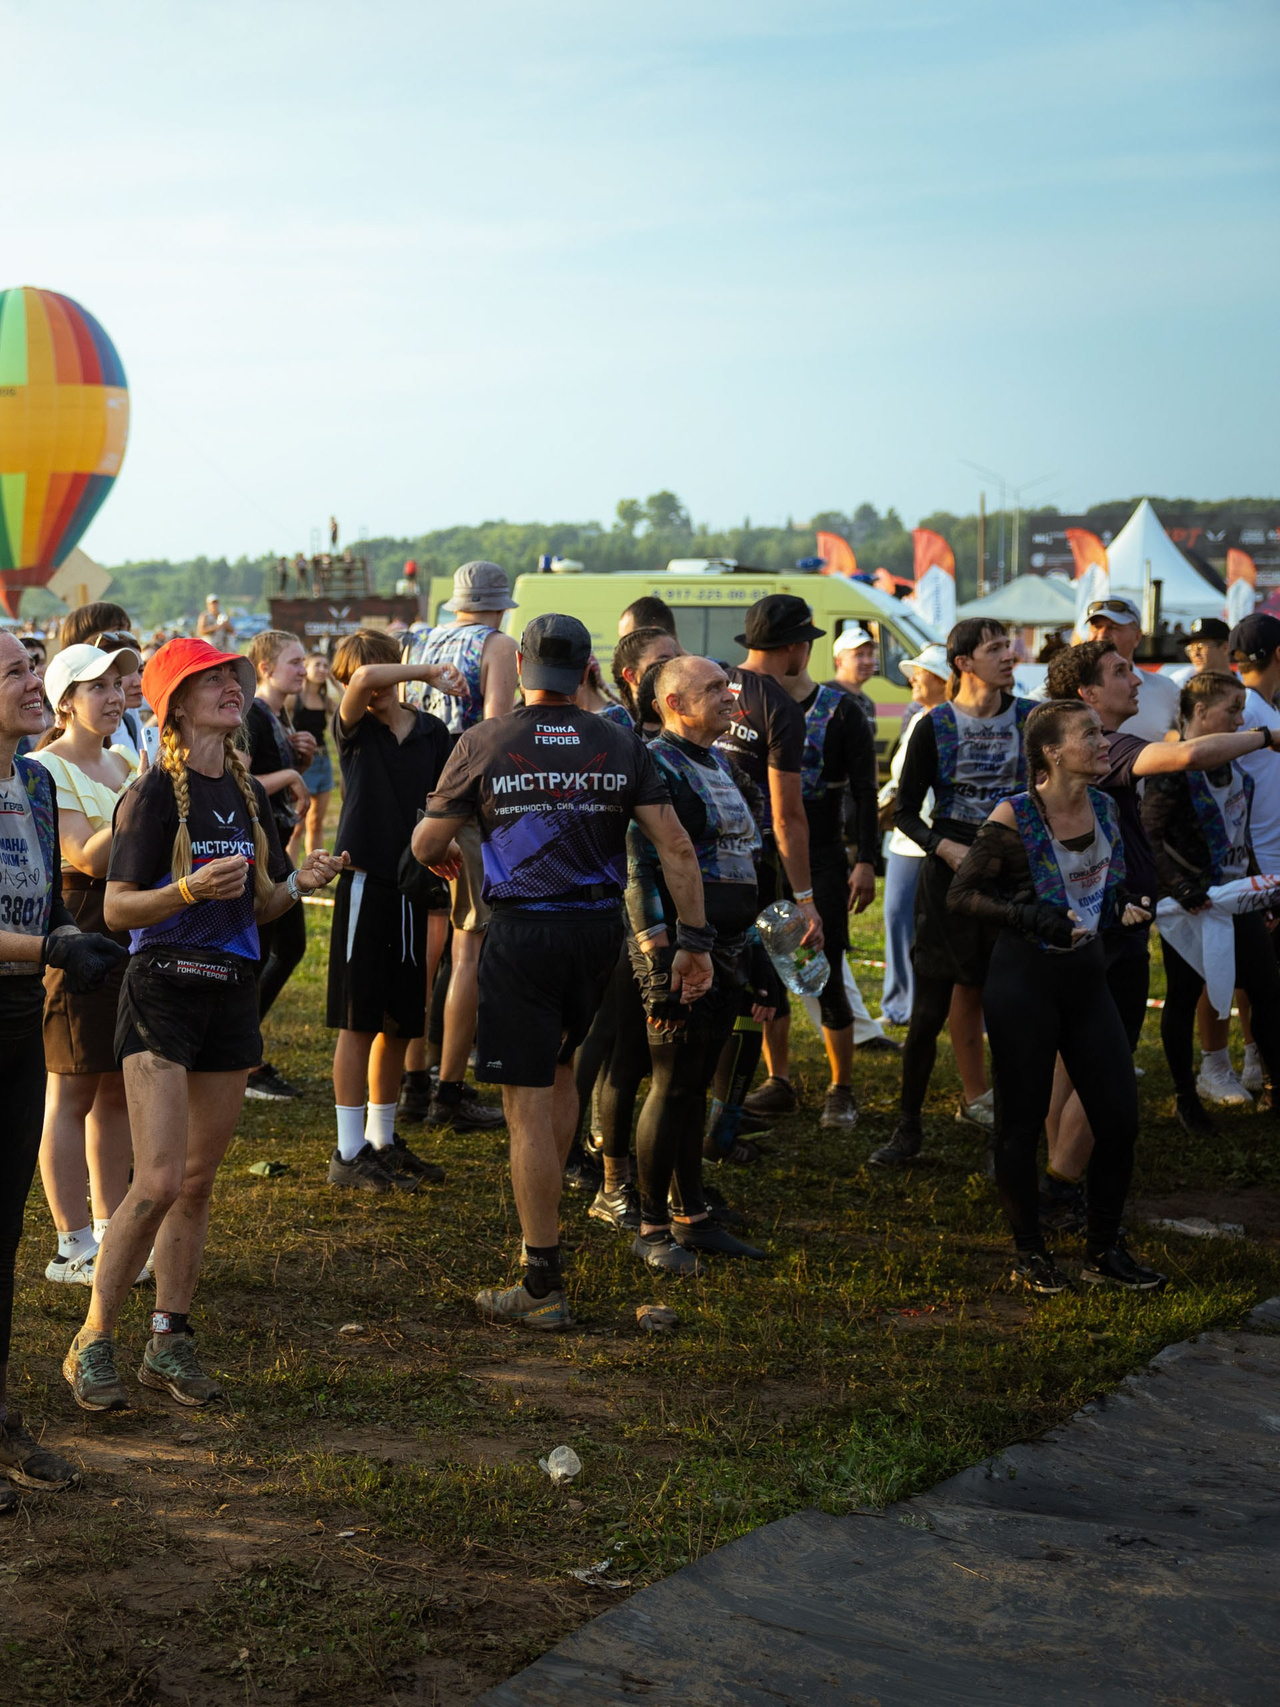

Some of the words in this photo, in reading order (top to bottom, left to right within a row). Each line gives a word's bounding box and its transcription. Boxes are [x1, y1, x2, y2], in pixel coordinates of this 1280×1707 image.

[536, 724, 576, 733] ГОНКА
[535, 736, 580, 745] ГЕРОЕВ
[492, 772, 627, 795] ИНСТРУКТОР
[494, 802, 552, 815] УВЕРЕННОСТЬ
[177, 966, 202, 976] ГОНКА
